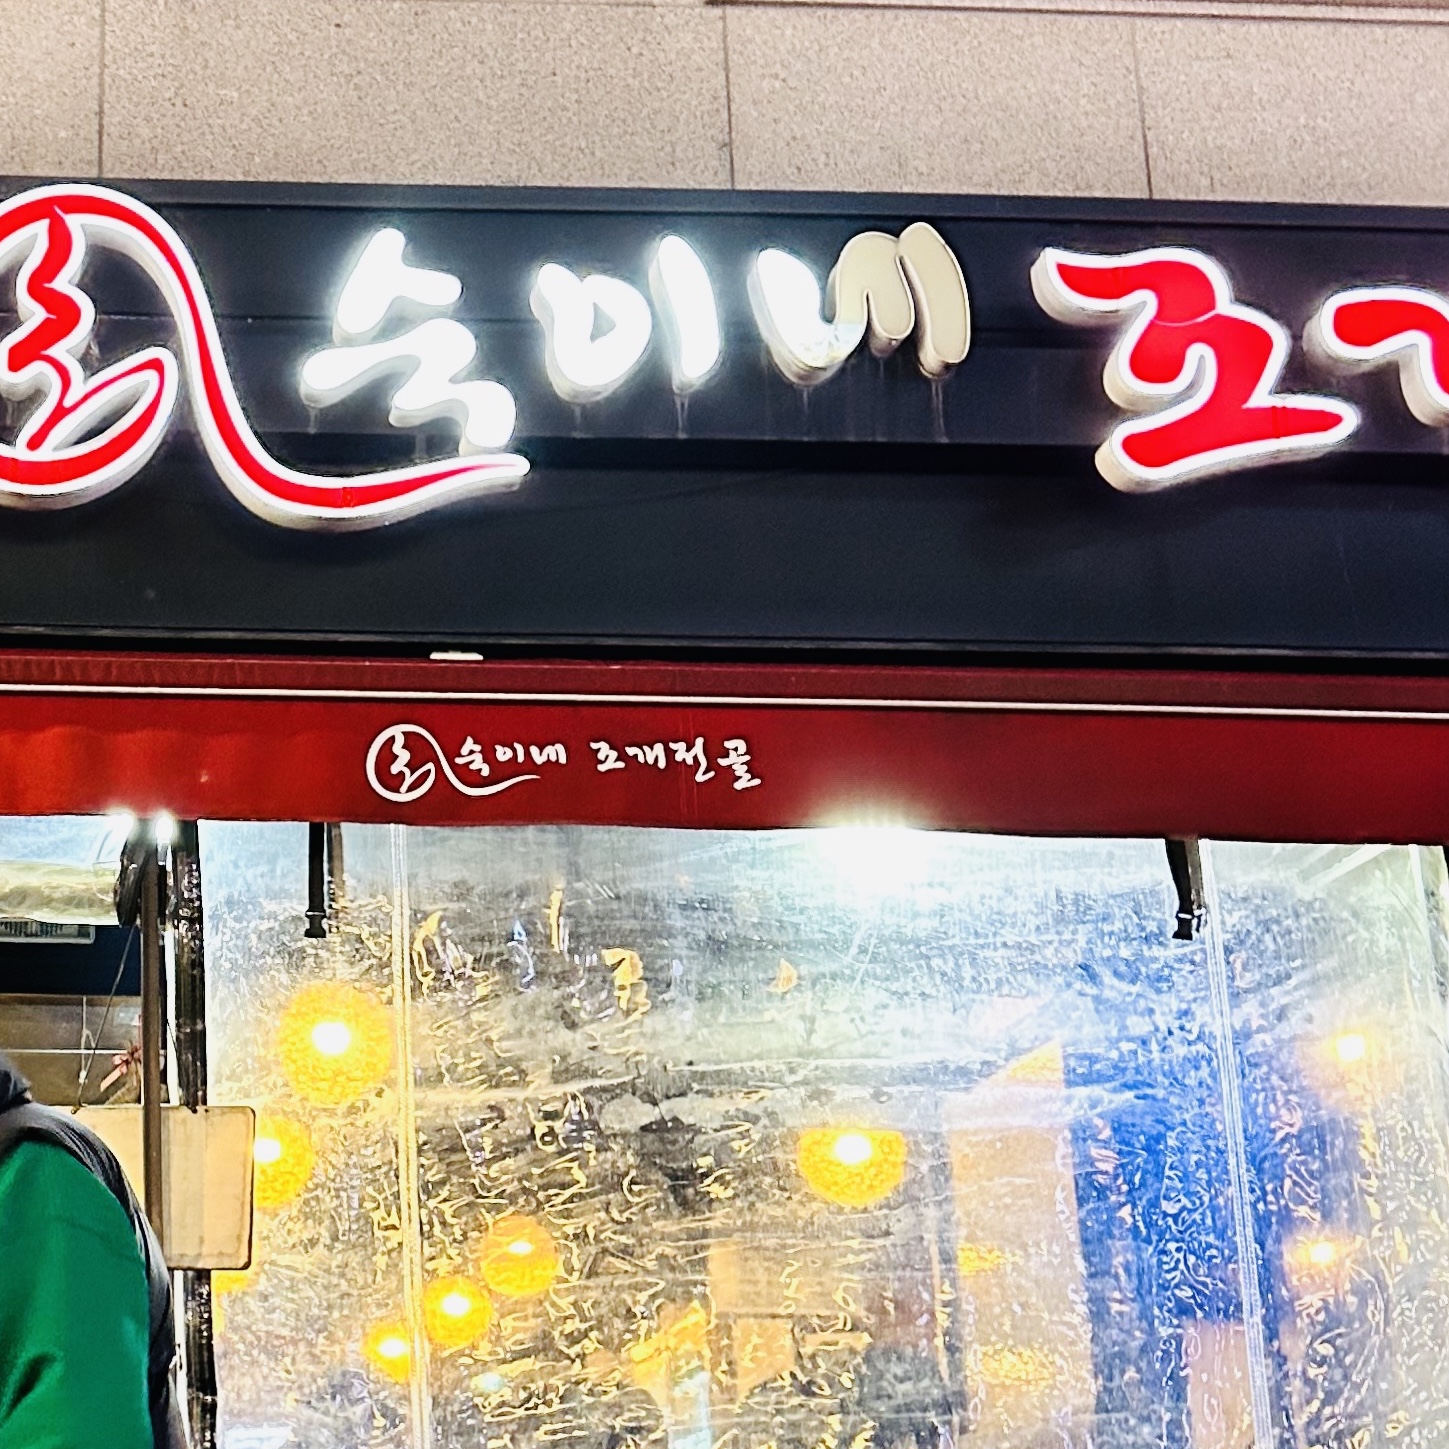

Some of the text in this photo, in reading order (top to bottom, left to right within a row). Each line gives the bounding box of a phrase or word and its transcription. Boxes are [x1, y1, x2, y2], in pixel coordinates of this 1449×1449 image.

[300, 221, 971, 453] 숙이네
[454, 735, 762, 791] 숙이네 조개전골
